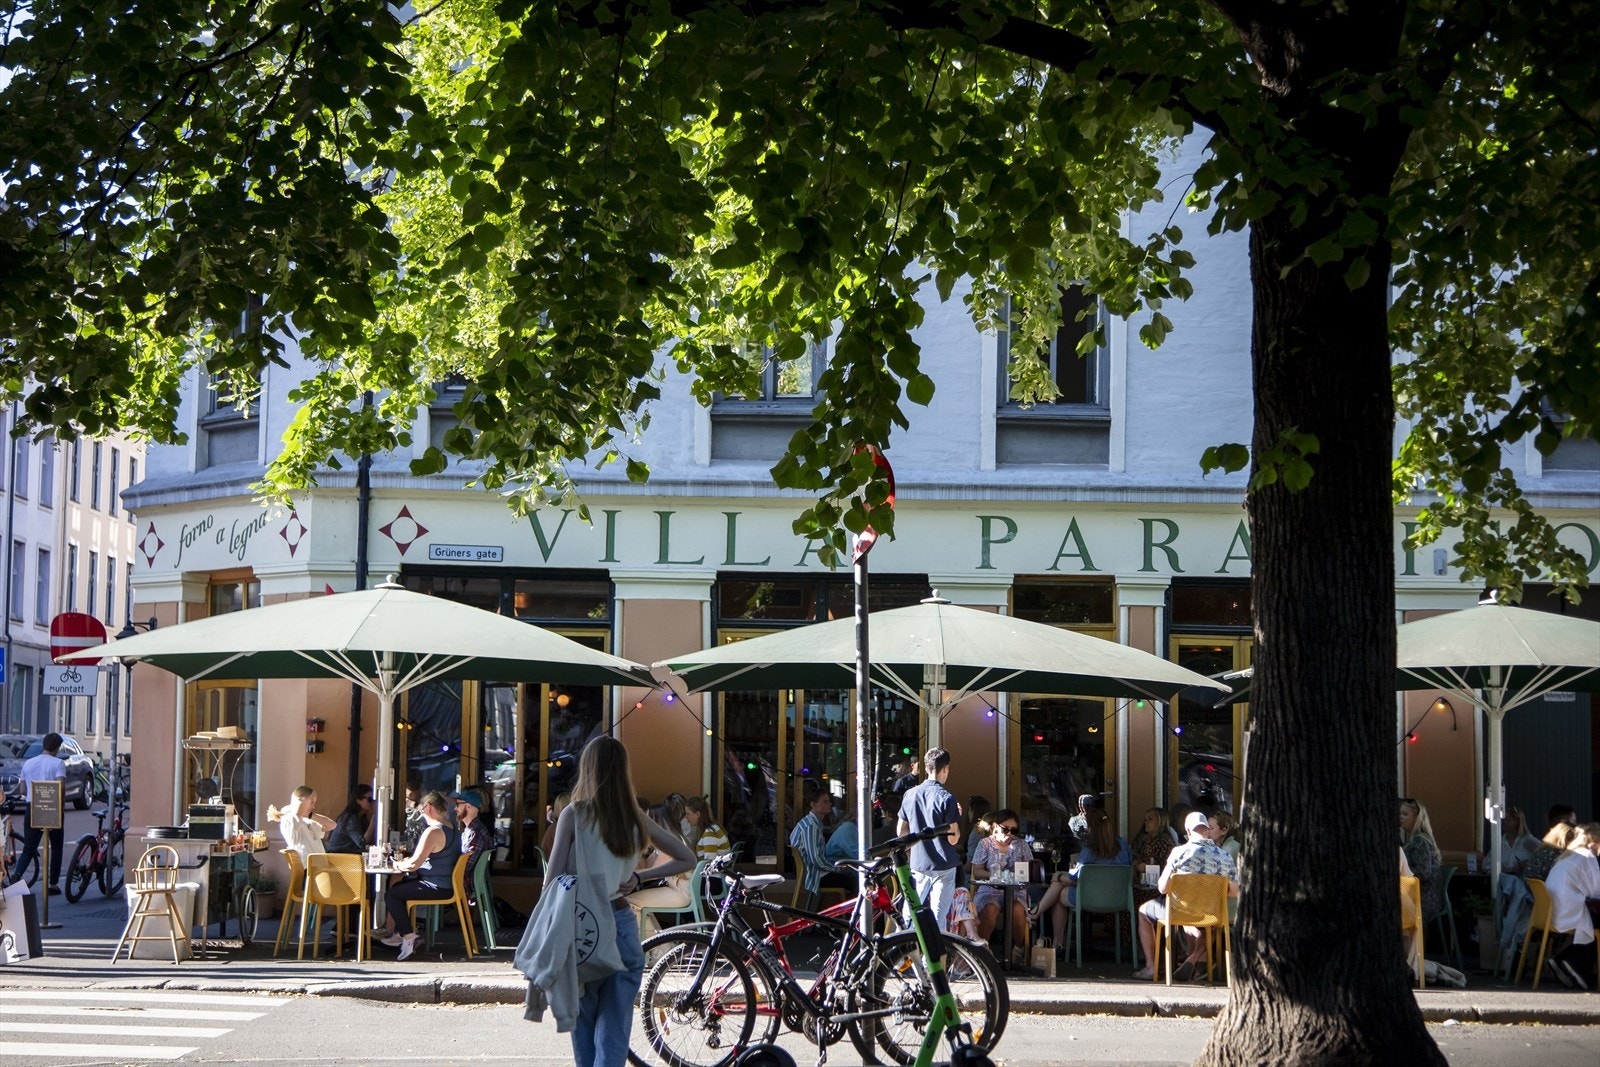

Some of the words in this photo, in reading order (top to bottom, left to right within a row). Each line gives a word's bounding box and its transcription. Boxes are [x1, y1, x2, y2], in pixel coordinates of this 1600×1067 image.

[174, 514, 214, 568] forno
[216, 528, 226, 544] a
[229, 510, 268, 561] legna
[435, 547, 471, 558] Grüners
[476, 549, 497, 560] gate
